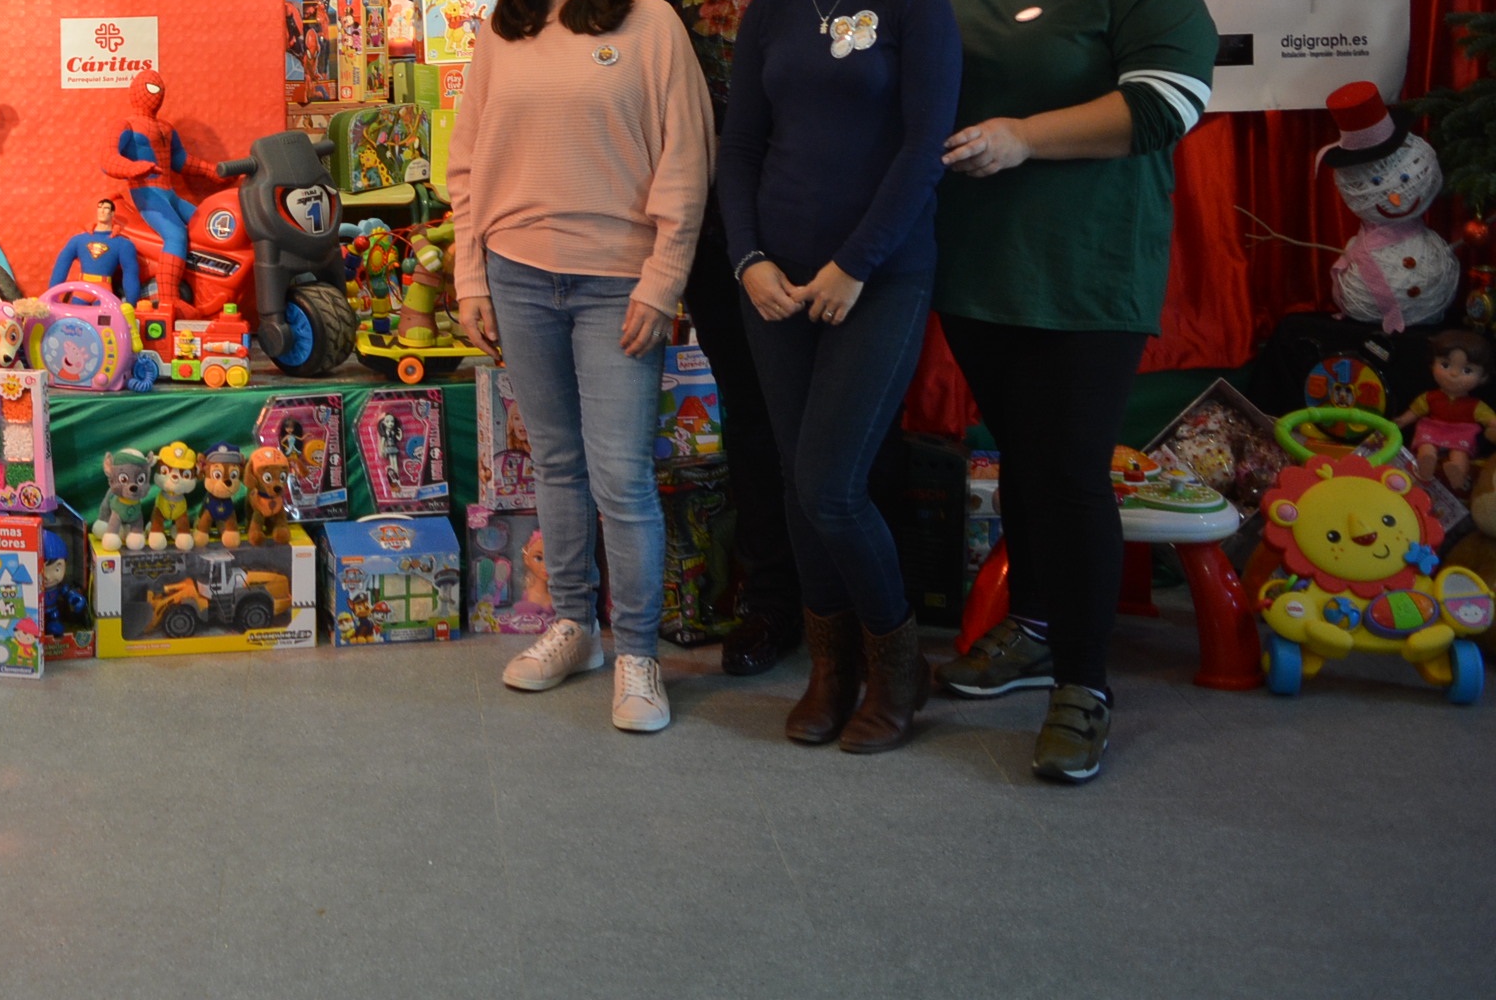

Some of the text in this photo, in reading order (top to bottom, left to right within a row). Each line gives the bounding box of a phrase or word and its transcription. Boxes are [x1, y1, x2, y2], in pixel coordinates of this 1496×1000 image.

[1281, 33, 1368, 50] digigraph.es
[67, 56, 153, 73] Cáritas
[116, 75, 129, 83] José
[306, 201, 324, 234] 1
[1333, 359, 1352, 384] 1
